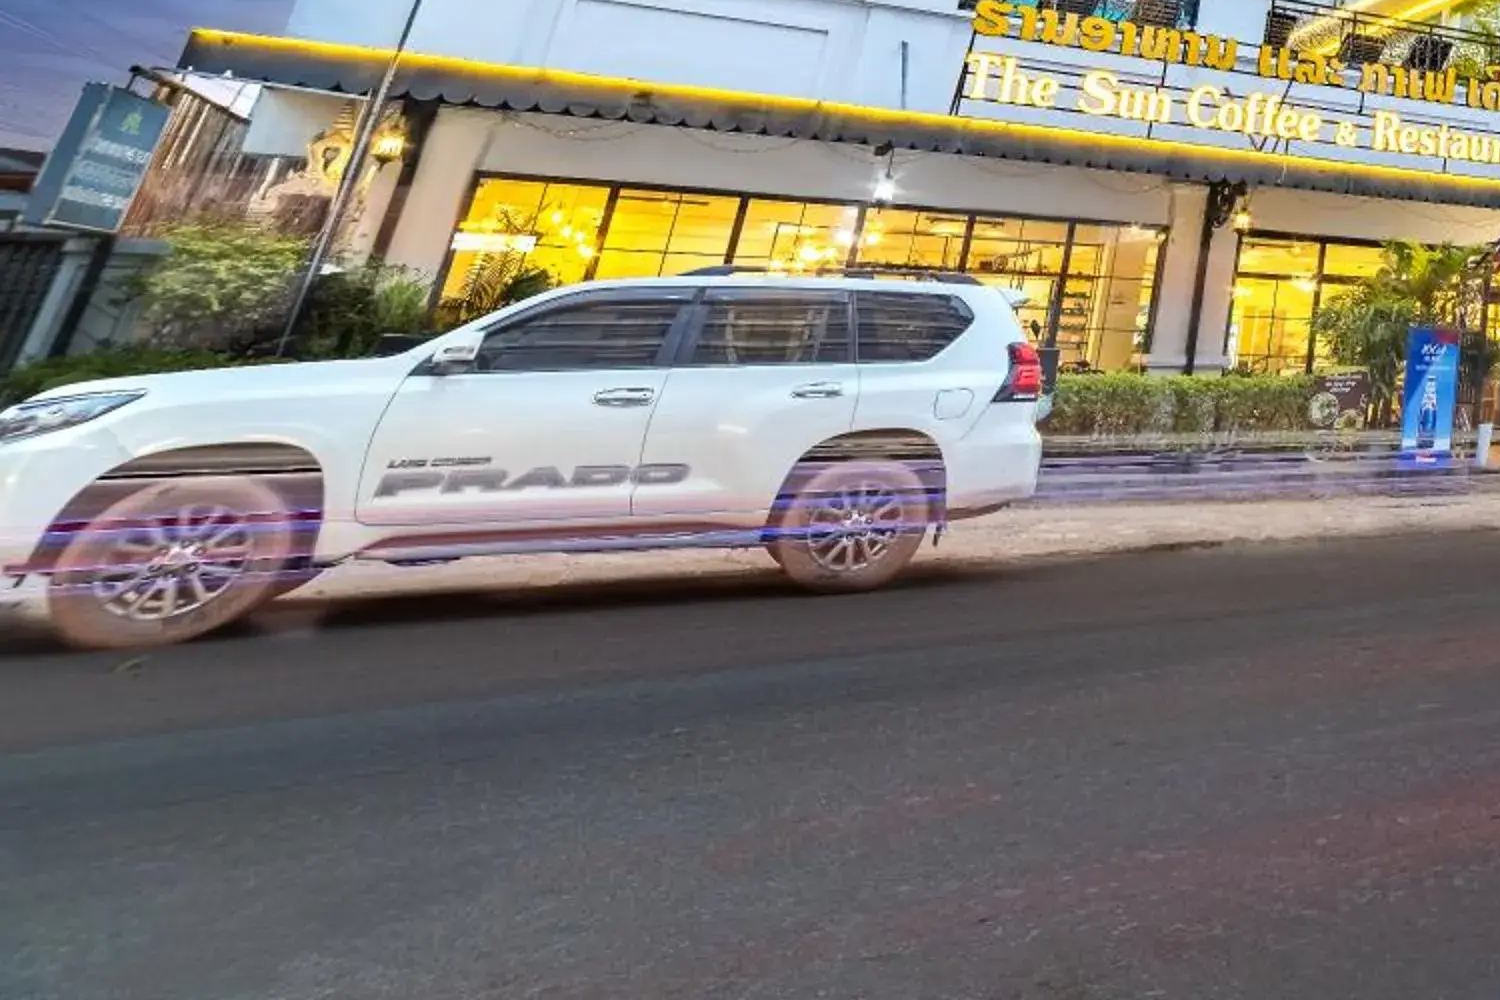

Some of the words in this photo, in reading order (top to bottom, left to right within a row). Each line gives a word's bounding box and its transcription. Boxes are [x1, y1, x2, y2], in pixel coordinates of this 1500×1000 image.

[969, 52, 1058, 107] The
[1077, 69, 1171, 124] Sun
[1186, 84, 1321, 142] Coffee
[1335, 120, 1358, 146] &
[373, 464, 691, 497] PRADO
